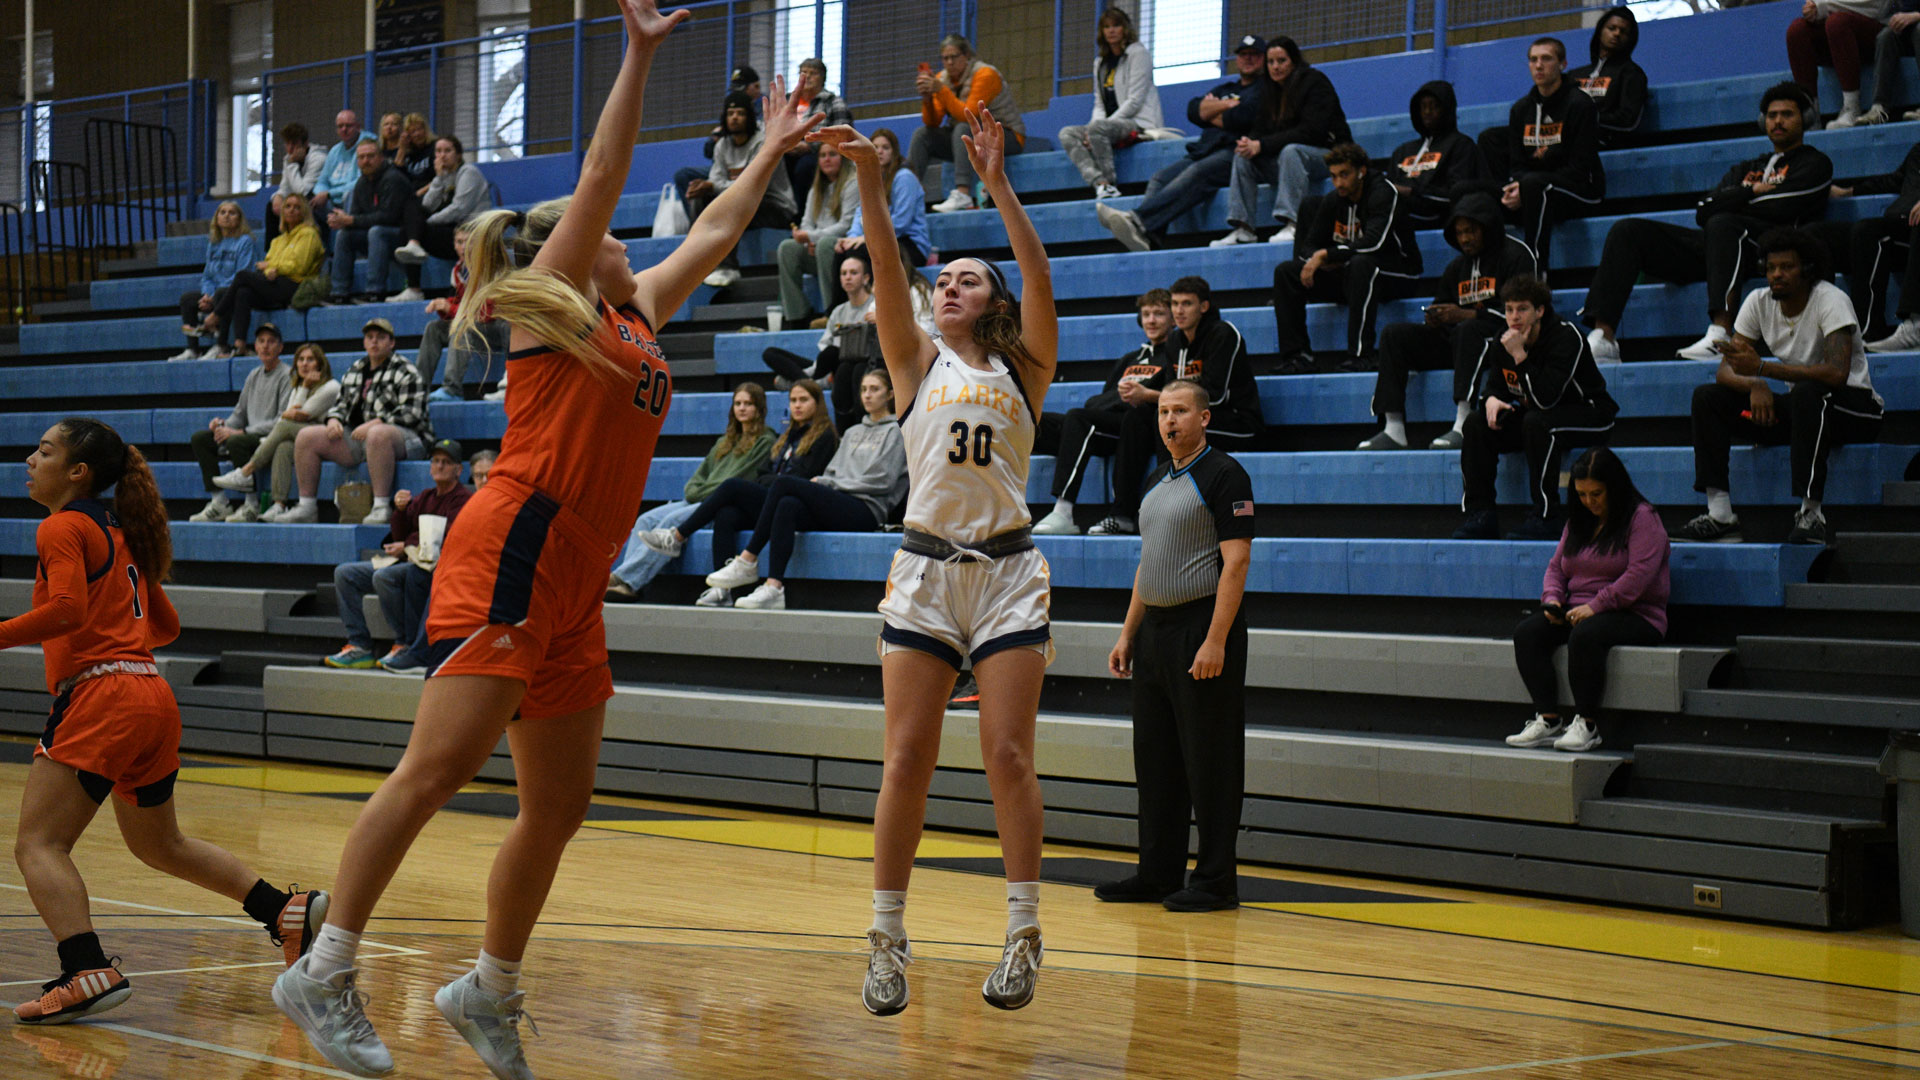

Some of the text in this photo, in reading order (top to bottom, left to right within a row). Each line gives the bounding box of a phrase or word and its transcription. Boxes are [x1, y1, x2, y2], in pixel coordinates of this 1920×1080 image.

[633, 360, 668, 416] 20
[926, 384, 1021, 425] CLARKE
[946, 419, 995, 470] 30
[127, 564, 143, 619] 1
